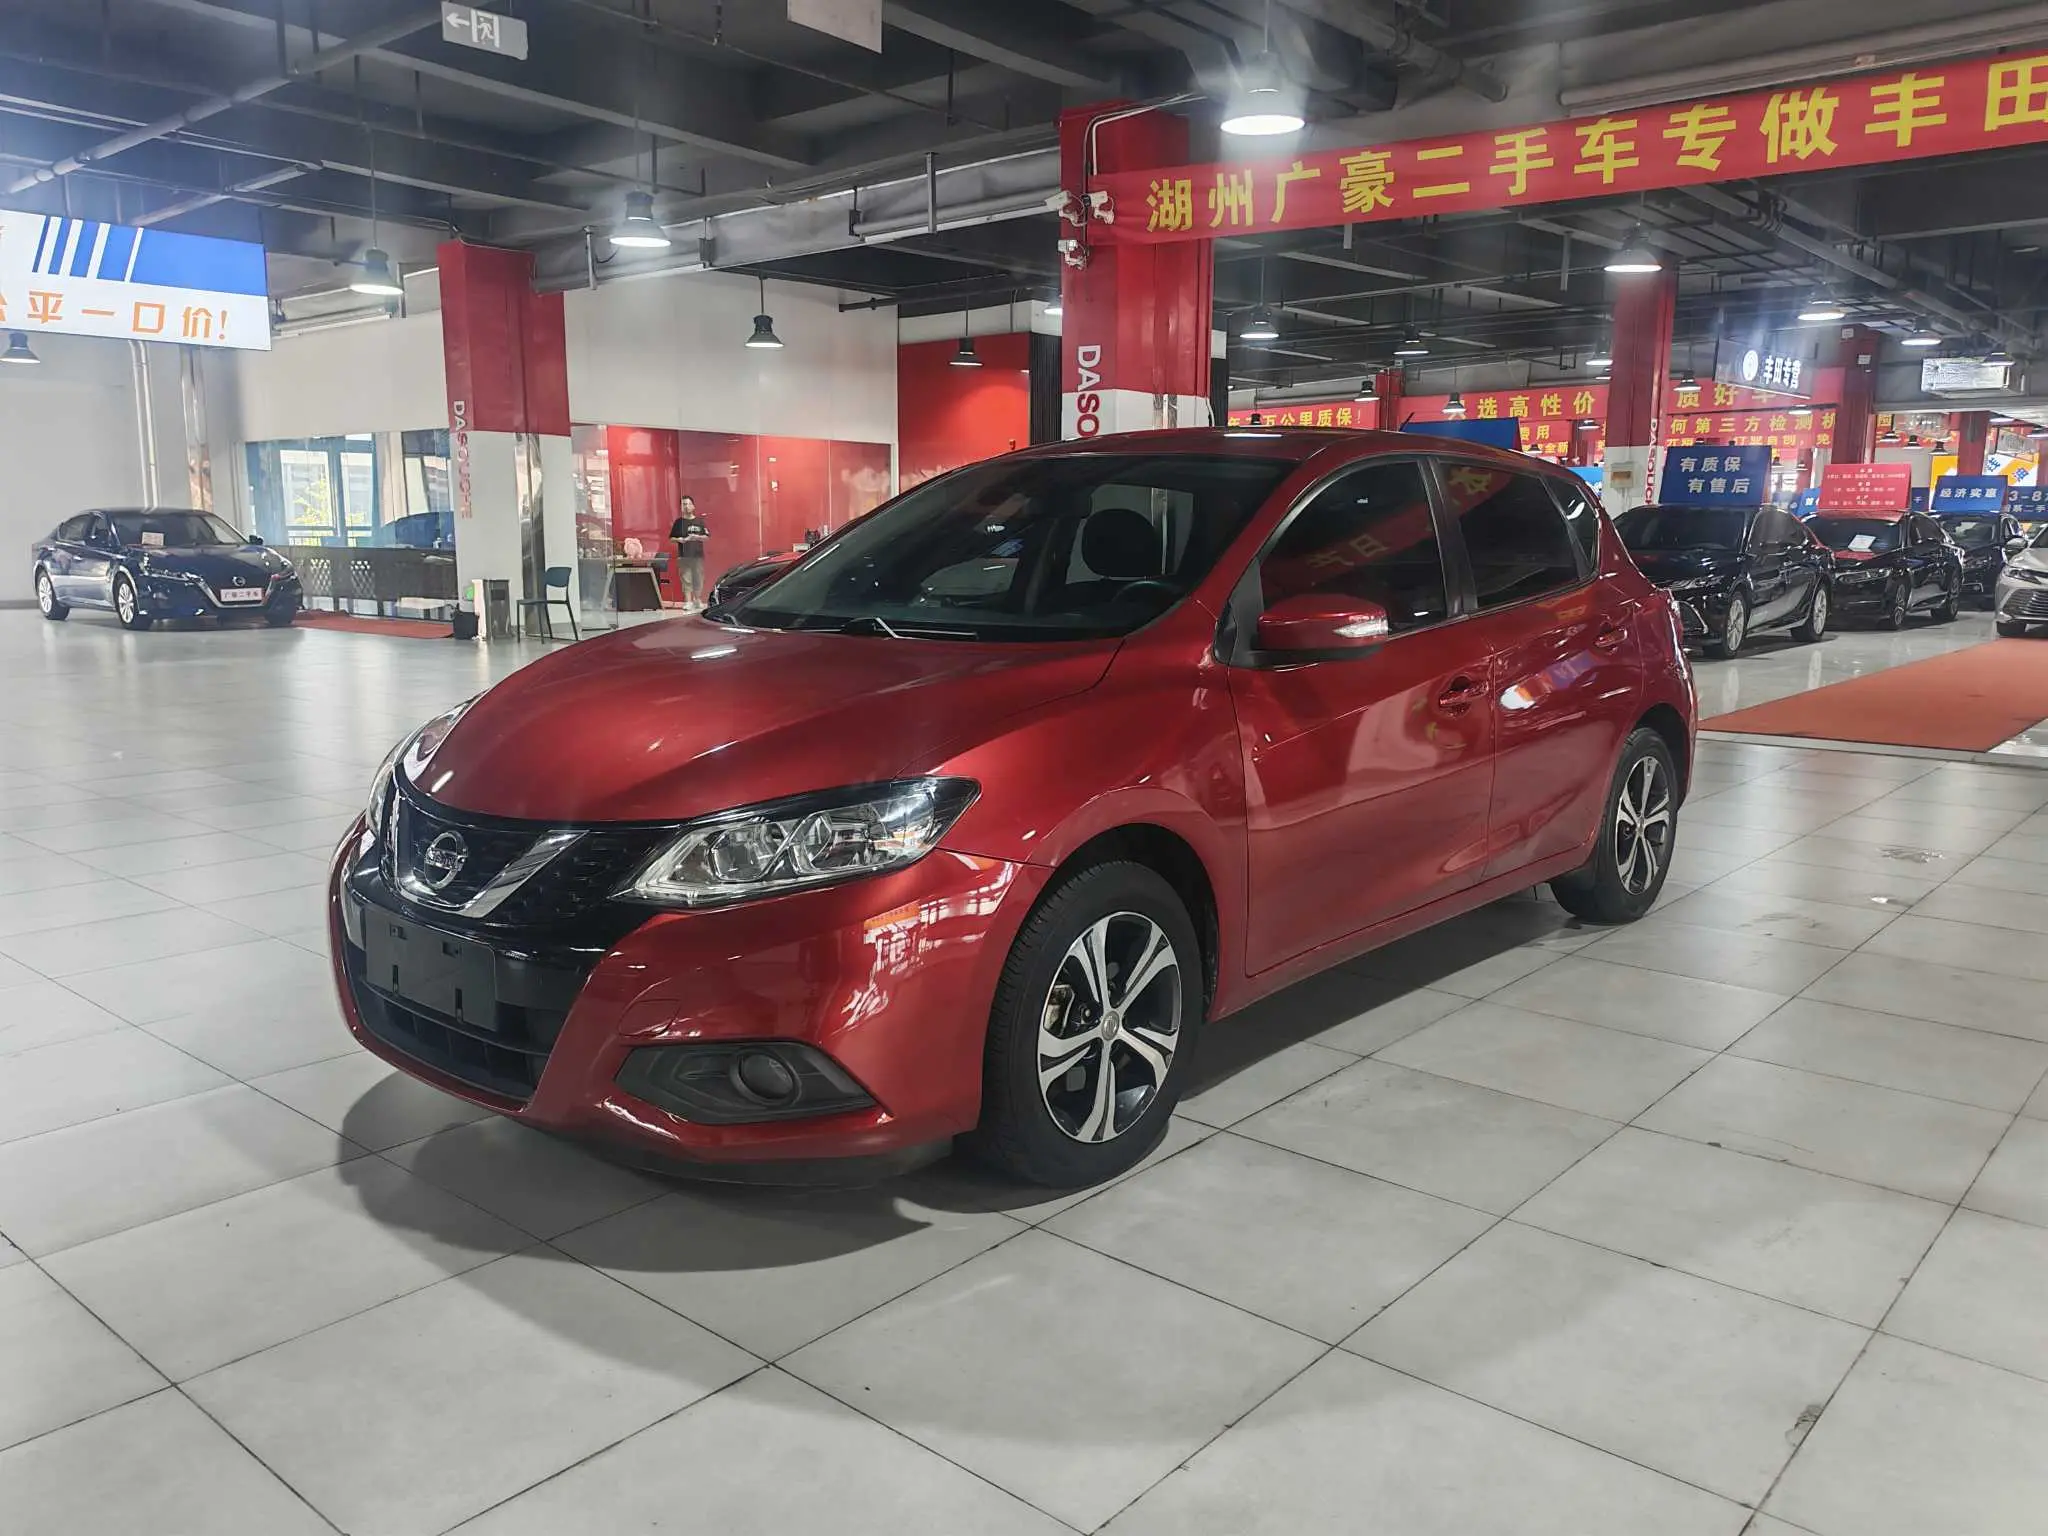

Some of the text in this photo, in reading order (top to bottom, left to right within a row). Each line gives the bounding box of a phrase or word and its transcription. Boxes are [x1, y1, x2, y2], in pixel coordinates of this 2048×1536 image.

[1146, 55, 2048, 233] 湖州广豪二手车专做丰田
[0, 289, 229, 340] 平一口价!
[1077, 344, 1101, 438] DASO
[1228, 407, 1361, 427] 年万公里质保!
[1680, 456, 1742, 472] 有质保
[1688, 478, 1750, 494] 有售后
[1940, 488, 1998, 498] 经济实惠
[2008, 490, 2048, 502] 3-8
